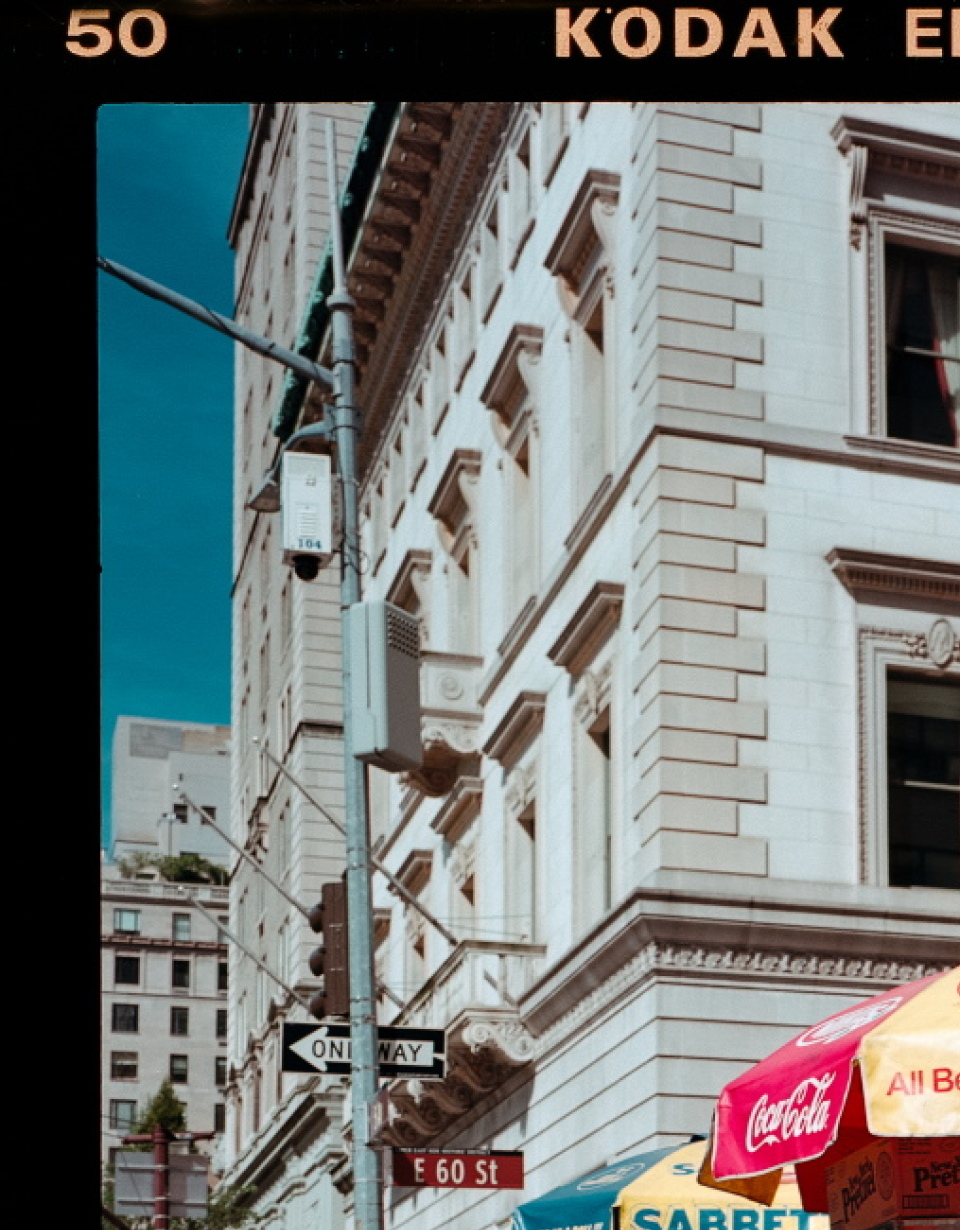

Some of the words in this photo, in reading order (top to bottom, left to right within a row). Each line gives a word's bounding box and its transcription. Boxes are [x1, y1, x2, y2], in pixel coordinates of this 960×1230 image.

[887, 1070, 924, 1096] All
[746, 1071, 836, 1153] Coca-Cola
[413, 1157, 425, 1183] E
[436, 1158, 465, 1185] 60
[475, 1158, 499, 1185] St
